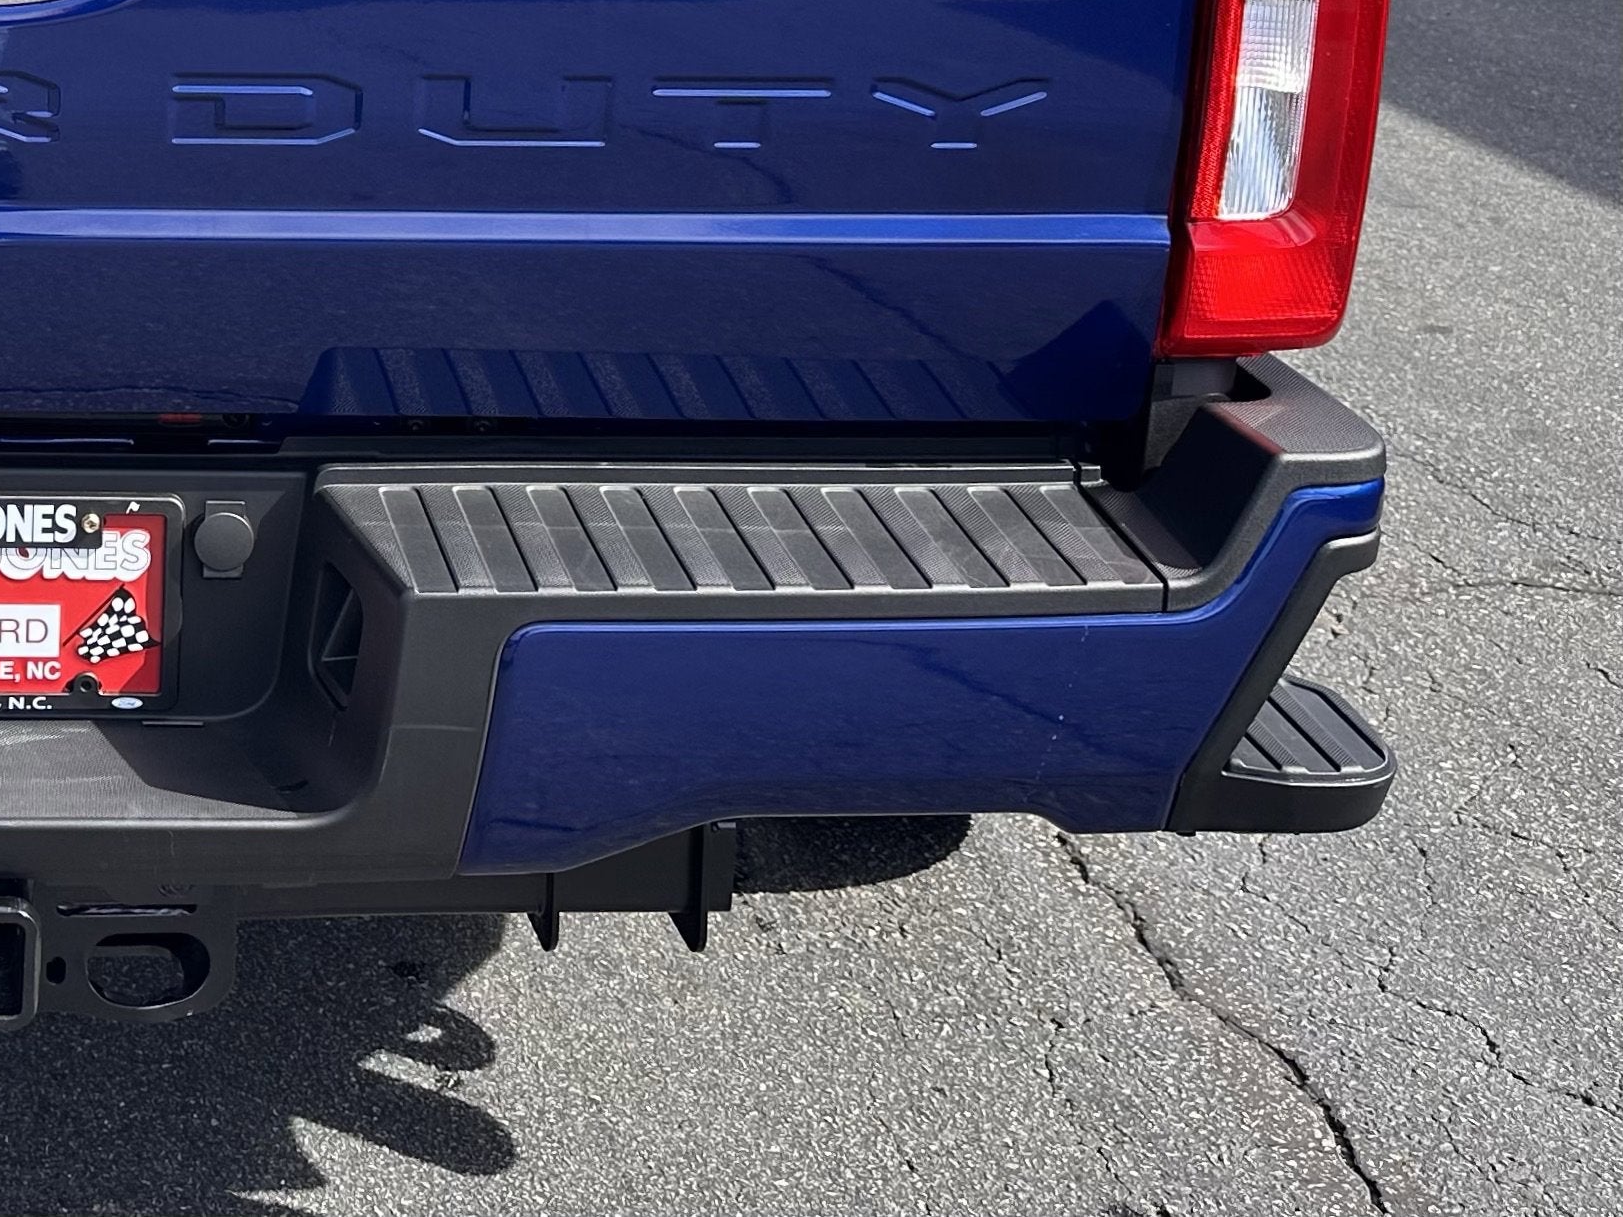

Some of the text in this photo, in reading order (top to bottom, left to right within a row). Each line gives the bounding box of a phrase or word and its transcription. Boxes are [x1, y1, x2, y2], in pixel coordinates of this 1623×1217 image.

[170, 68, 1052, 151] DUTY
[26, 660, 62, 681] NC
[8, 696, 53, 711] N.C.
